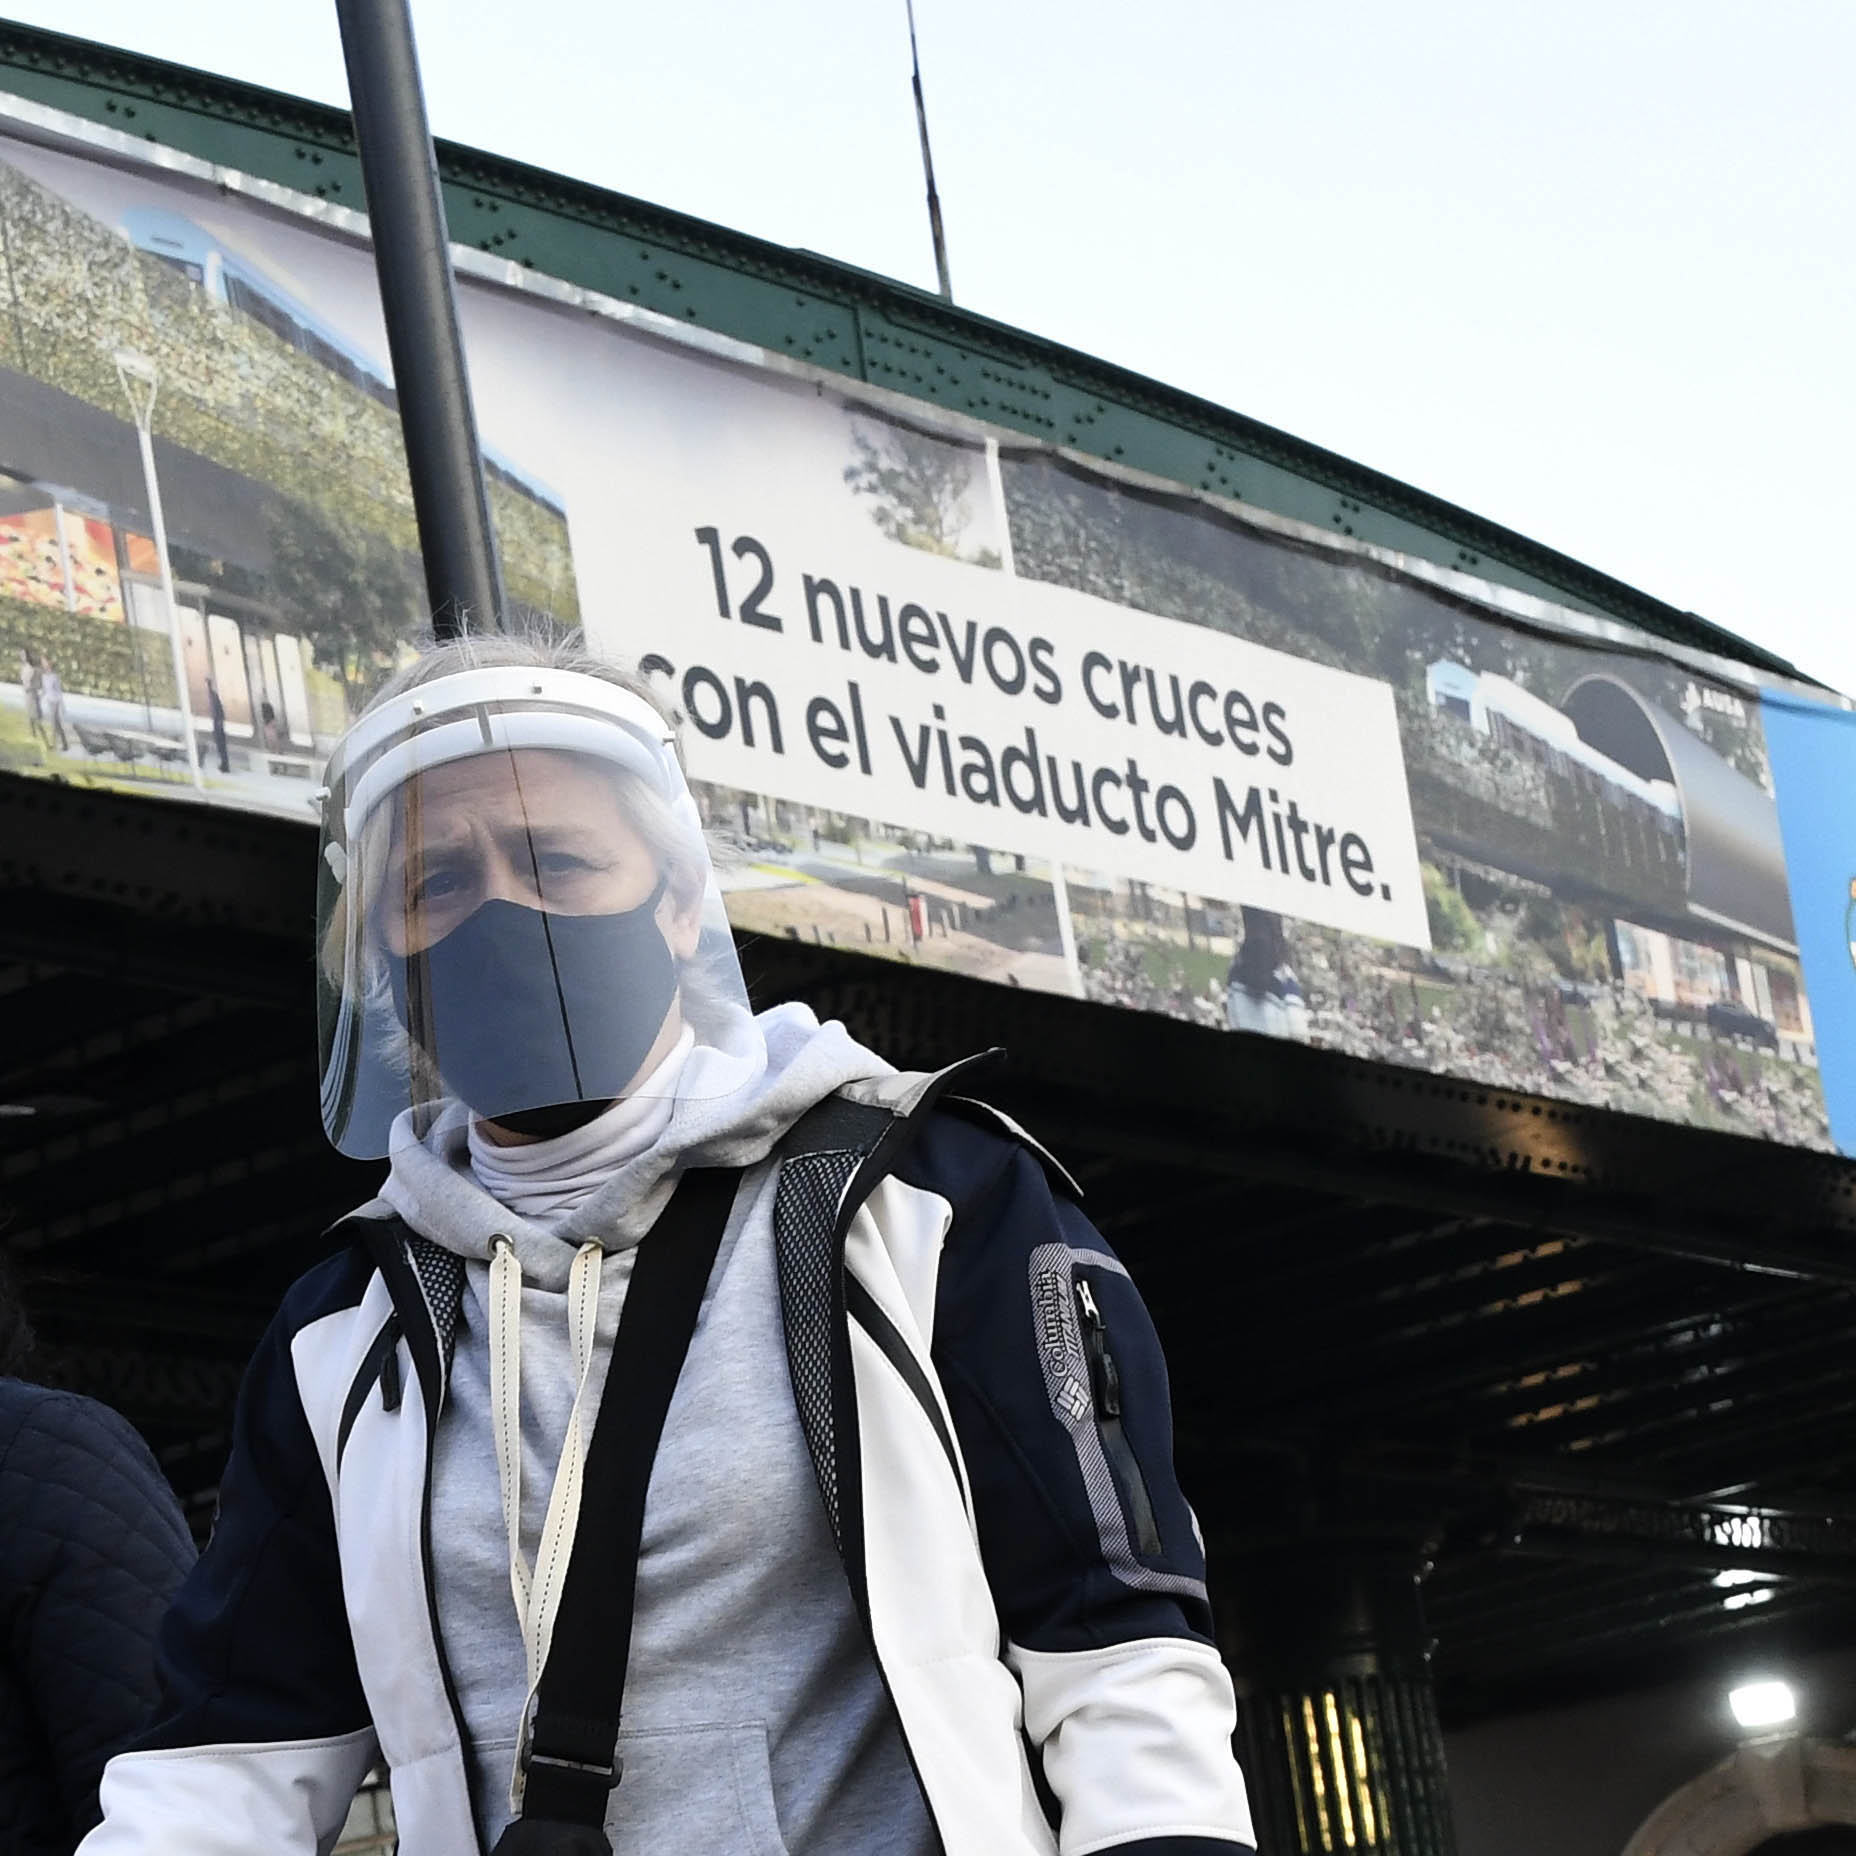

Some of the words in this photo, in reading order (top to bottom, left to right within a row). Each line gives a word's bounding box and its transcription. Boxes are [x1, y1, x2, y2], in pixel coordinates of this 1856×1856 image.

[695, 525, 783, 634] 12
[802, 573, 1062, 706] nuevos
[1081, 648, 1295, 768] cruces
[805, 679, 872, 777] el
[890, 706, 1197, 853] viaducto
[1213, 776, 1393, 902] Mitre.
[1039, 1270, 1068, 1377] Columbia
